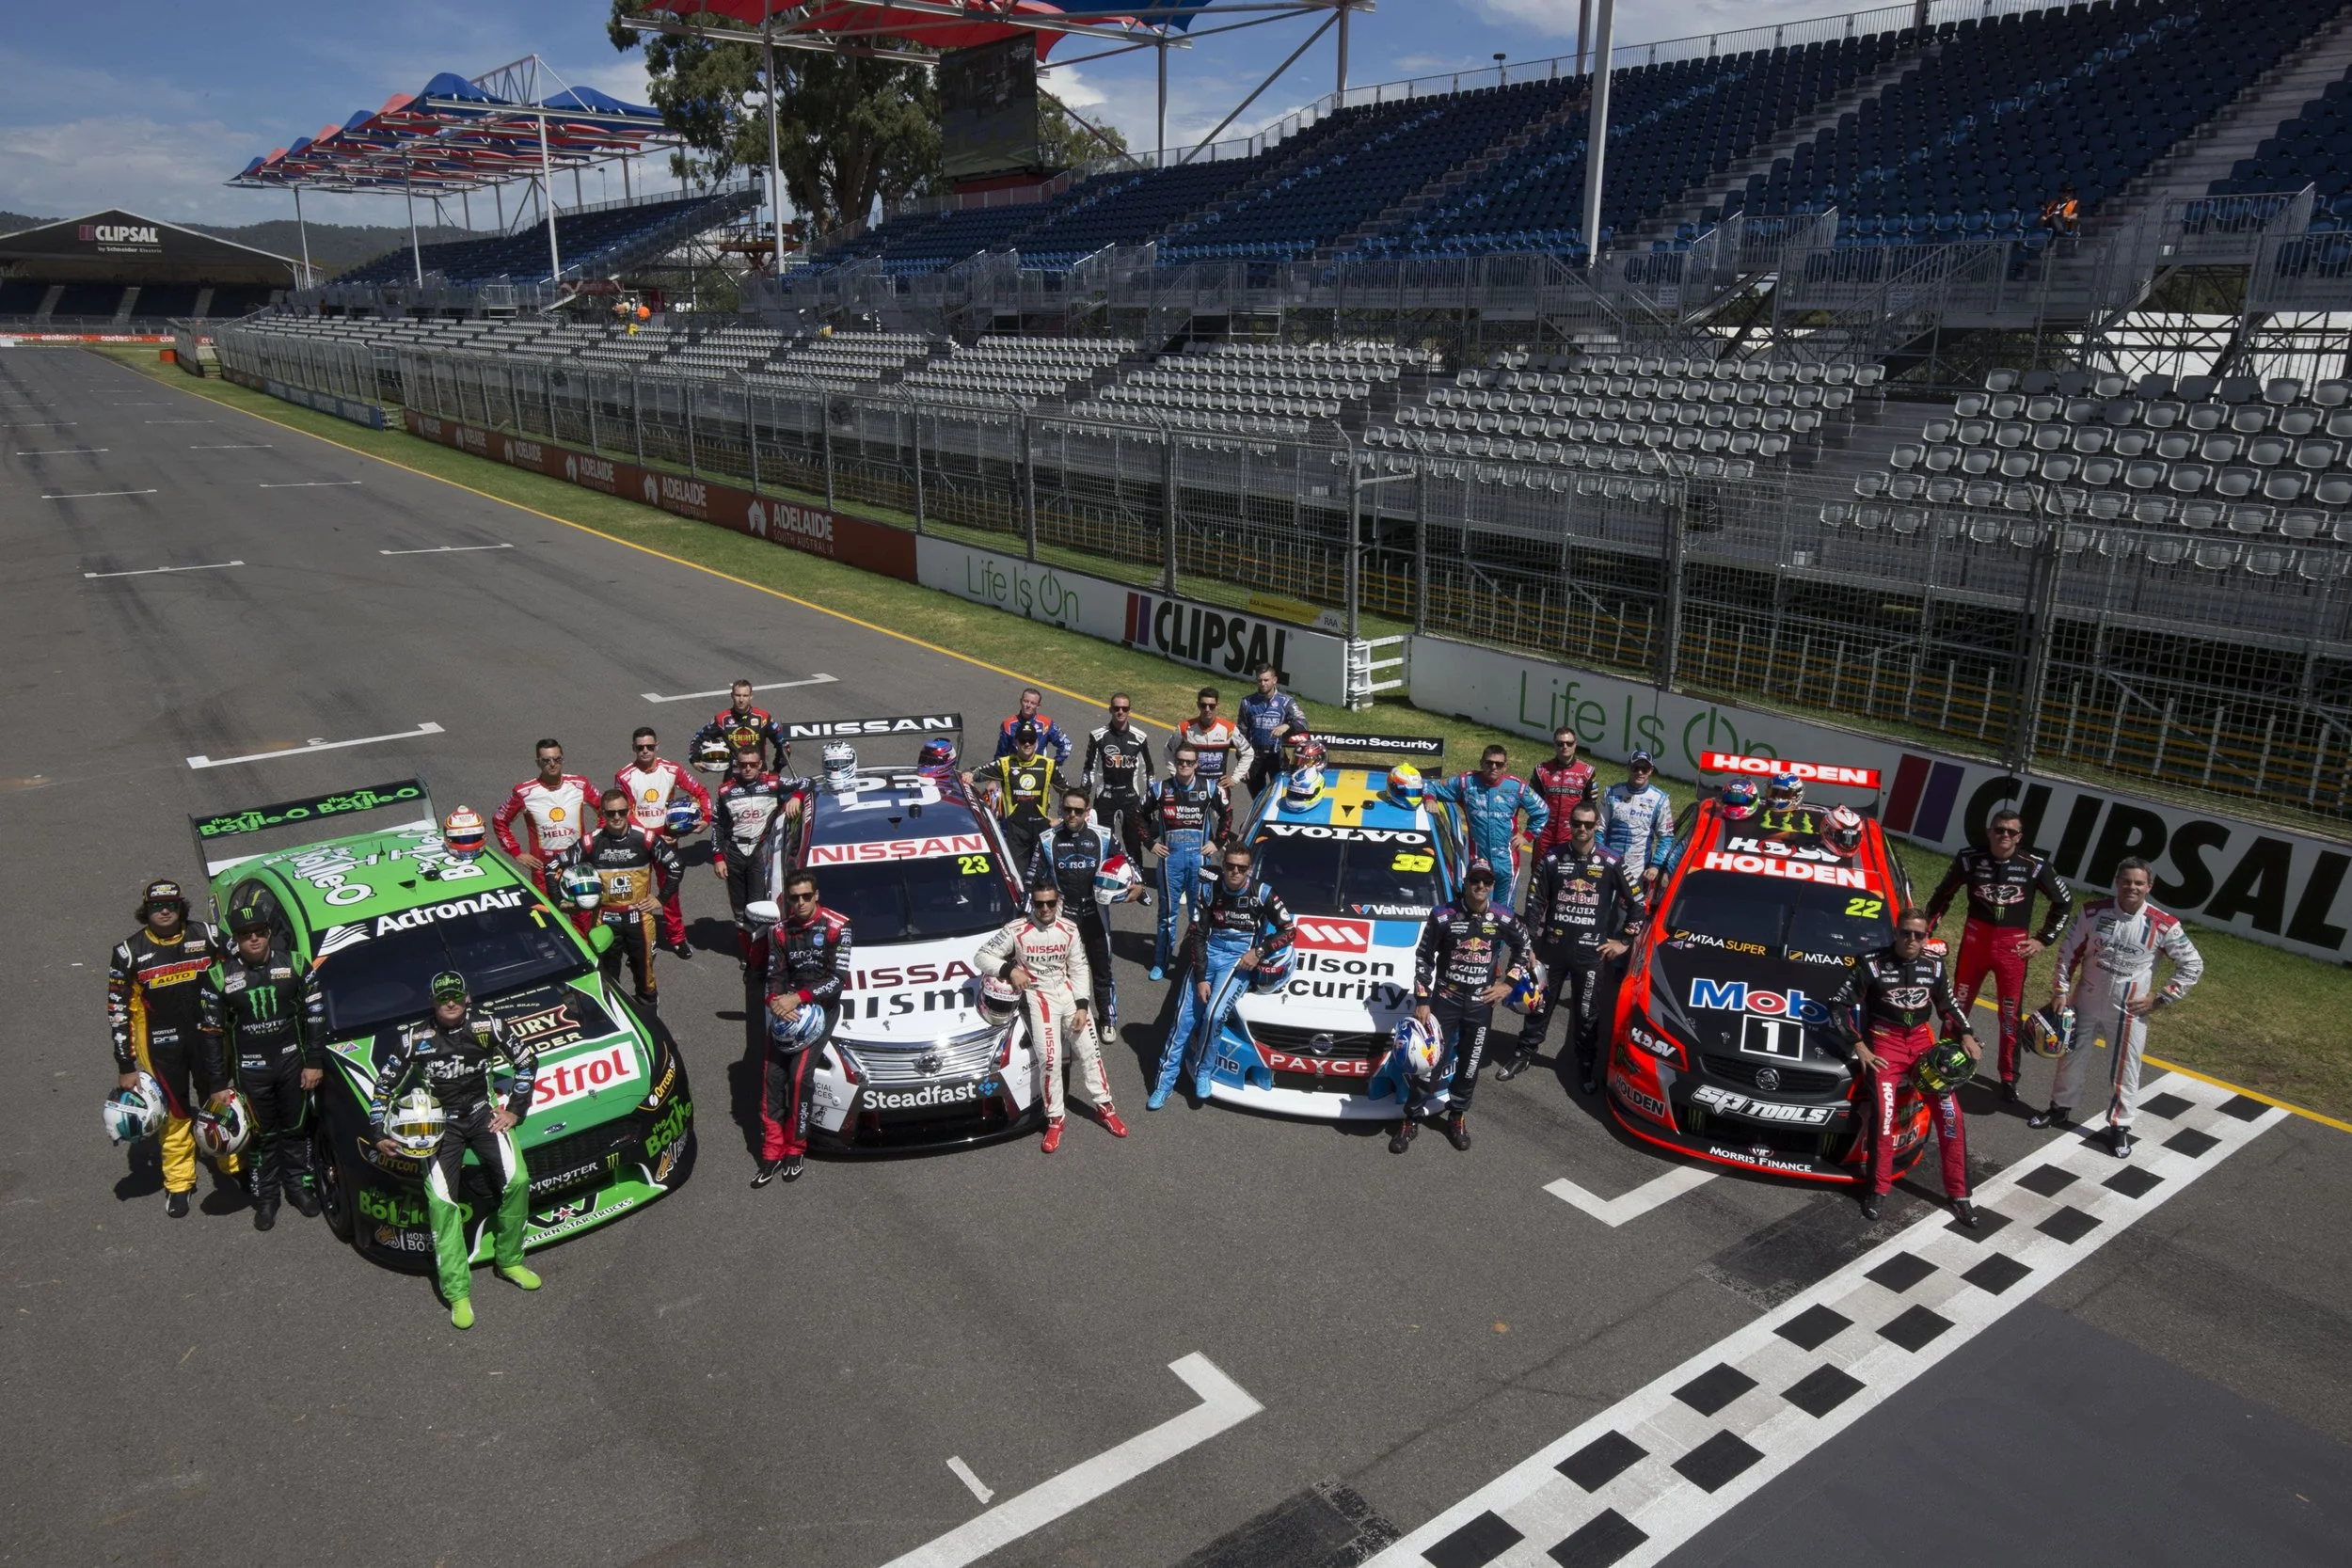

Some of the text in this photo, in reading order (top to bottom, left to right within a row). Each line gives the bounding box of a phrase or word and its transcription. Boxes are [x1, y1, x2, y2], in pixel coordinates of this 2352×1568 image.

[95, 226, 158, 243] CLIPSAL
[580, 456, 615, 483] ADELAIDE
[662, 476, 707, 508] ADELAIDE
[773, 503, 834, 542] ADELAIDE
[773, 530, 834, 557] SOUTH AUSTRALIA
[966, 555, 1079, 623] Life Is On
[1324, 617, 1338, 627] RAA
[1154, 601, 1290, 686] CLIPSAL
[1519, 670, 1606, 743] Life
[1624, 694, 1664, 759] Is
[728, 734, 760, 742] PENRITE
[790, 717, 953, 737] NISSAN
[1310, 735, 1438, 750] Wilson Security
[1712, 754, 1867, 784] HOLDEN
[211, 817, 231, 826] the
[637, 809, 665, 817] HELIX
[543, 828, 576, 839] HELIX
[1265, 824, 1427, 845] VOLVO
[812, 834, 983, 864] NISSAN
[958, 855, 990, 875] 23
[1057, 860, 1096, 870] carsales
[1199, 867, 1219, 881] OSHIBA
[1391, 853, 1435, 873] 33
[1704, 851, 1867, 889] HOLDEN
[1963, 776, 2351, 951] CLIPSAL
[610, 875, 632, 888] ICE
[1373, 904, 1434, 917] Valvolin
[1558, 892, 1599, 906] Red Bull
[1565, 905, 1596, 916] CALTEX
[1845, 898, 1882, 918] 22
[376, 889, 522, 937] ActronAir
[530, 909, 547, 928] 1
[1225, 911, 1251, 919] Wilson
[1554, 913, 1596, 926] HOLDEN
[1026, 943, 1066, 954] NISSAN
[1271, 930, 1295, 950] PAYC
[1688, 932, 1766, 957] MTAA SUPER
[1296, 952, 1394, 977] ilson
[1451, 950, 1492, 963] Red Bull
[1804, 952, 1844, 967] MTAA
[137, 957, 213, 983] SUPERCHEAP
[156, 972, 191, 986] AUTO
[845, 960, 977, 991] ISSA
[1446, 971, 1487, 985] HOLDEN
[839, 988, 975, 1020] nism
[1278, 979, 1410, 1010] curity
[1689, 977, 1834, 1026] Mob
[528, 1032, 583, 1054] IDER
[1044, 1027, 1055, 1071] NISSAN
[1761, 1021, 1781, 1053] 1
[1270, 1054, 1371, 1074] PAYCE
[534, 1048, 630, 1105] strol
[654, 1068, 675, 1100] Orrcon
[863, 1081, 977, 1110] Steadfast
[1616, 1075, 1665, 1117] HOLDEN
[1747, 1101, 1829, 1125] TOOLS
[1882, 1082, 1894, 1136] HOLDEN
[1892, 1125, 1920, 1150] LDEN
[377, 1151, 419, 1174] Orrcon
[1708, 1146, 1756, 1164] MORRIS
[1758, 1157, 1812, 1173] FINANCE
[529, 1162, 599, 1193] MONSTER
[523, 1198, 634, 1244] STERN STAR TRUCKS
